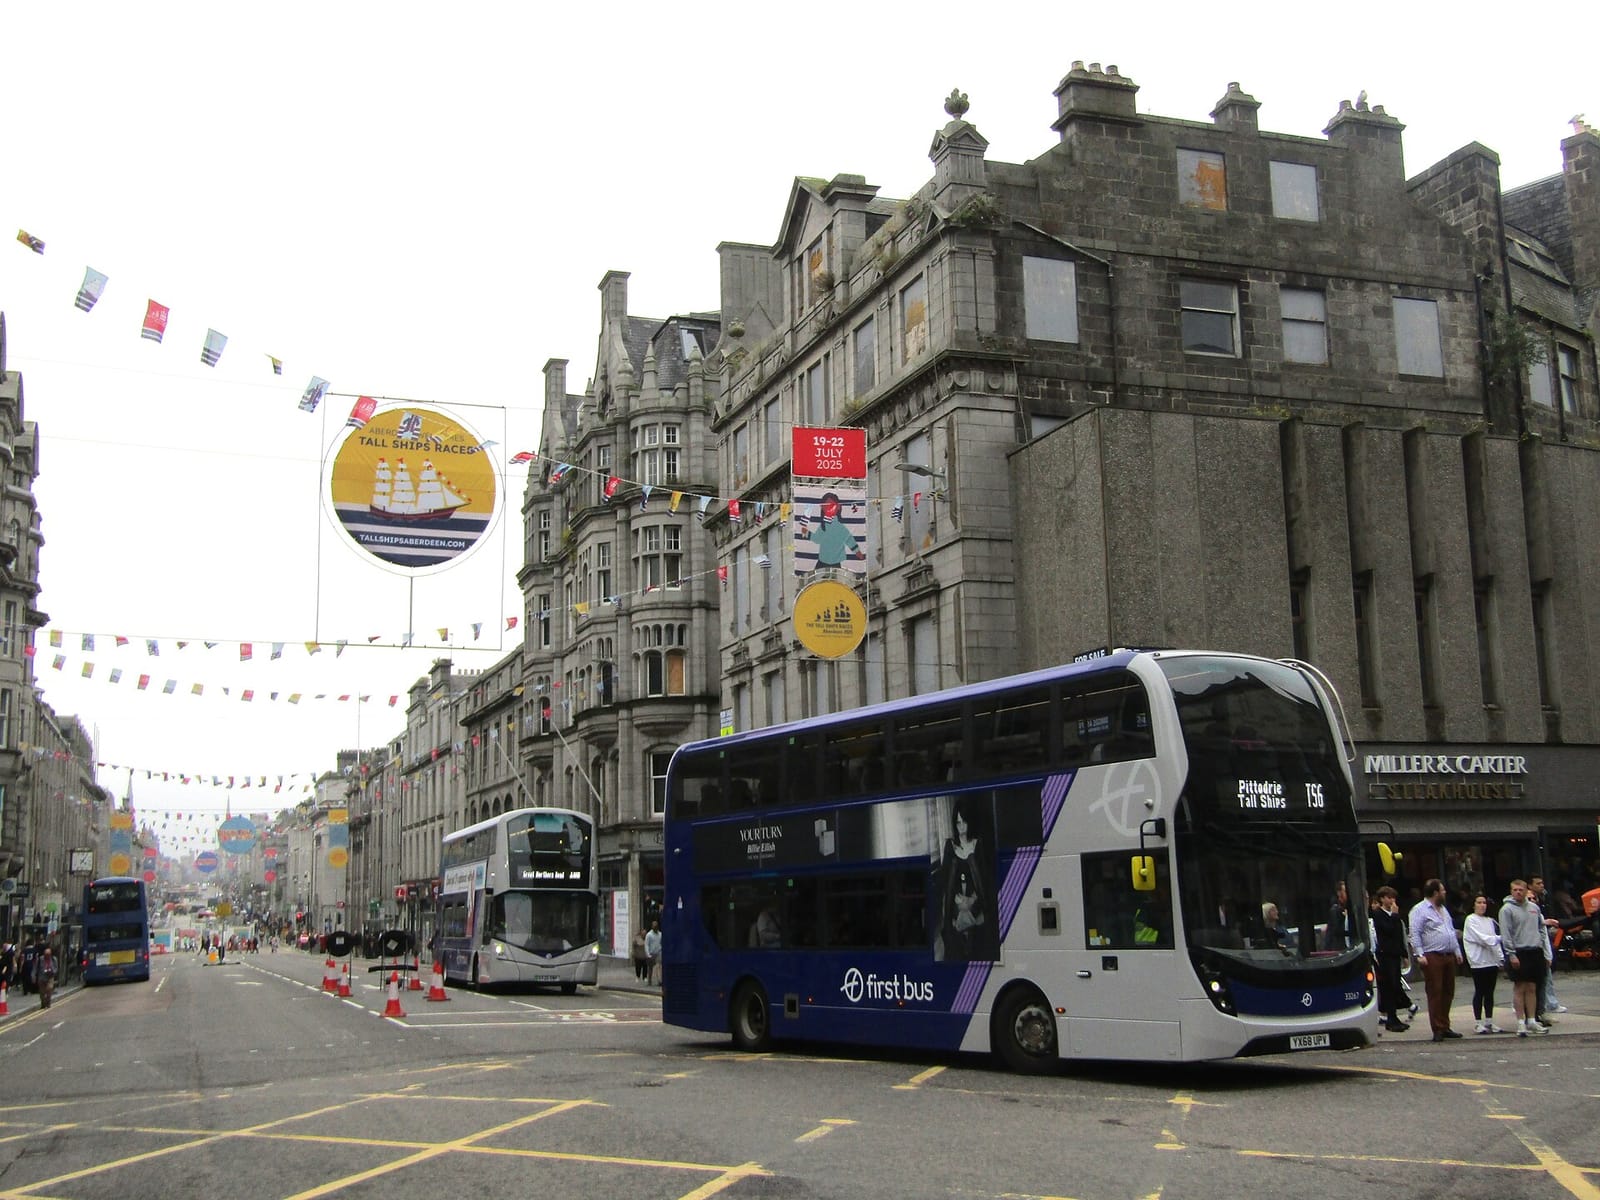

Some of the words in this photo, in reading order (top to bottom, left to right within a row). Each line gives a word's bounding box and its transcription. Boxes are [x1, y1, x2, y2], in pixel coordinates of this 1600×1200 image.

[359, 436, 388, 448] TALL
[392, 439, 431, 452] SHIPS
[813, 436, 845, 446] 19-22
[815, 448, 843, 458] JULY
[816, 459, 843, 470] 2025
[359, 534, 465, 548] TALLSHIPSABERDEEN.COM
[1089, 649, 1106, 661] SALE
[1364, 754, 1437, 773] MILLER
[1456, 755, 1529, 774] CARTER
[1238, 779, 1282, 795] Pittodrie
[1305, 783, 1325, 808] TS6
[1386, 782, 1513, 800] STEAKHOUSE
[1237, 794, 1258, 808] Tall
[1260, 794, 1287, 809] Ships
[739, 827, 760, 842] YOUR
[760, 825, 783, 840] TURN
[866, 973, 900, 1000] first
[903, 974, 934, 1001] bus
[1292, 1036, 1312, 1048] YX68
[1313, 1034, 1327, 1047] UPV
